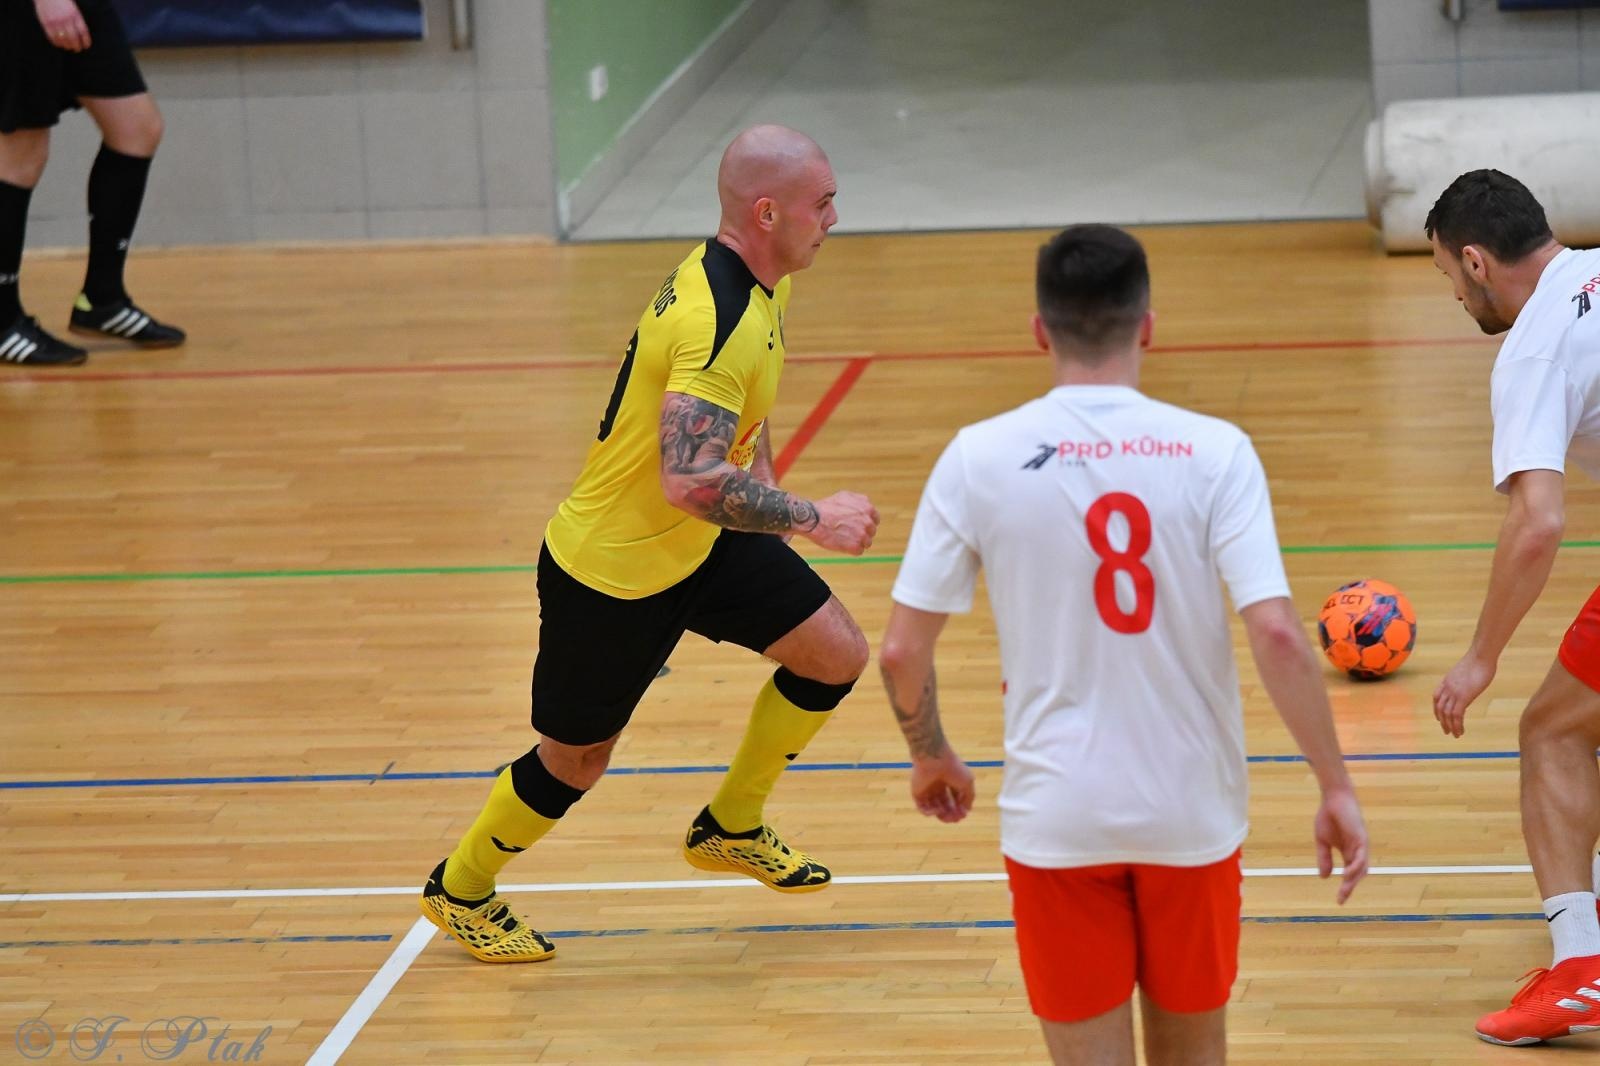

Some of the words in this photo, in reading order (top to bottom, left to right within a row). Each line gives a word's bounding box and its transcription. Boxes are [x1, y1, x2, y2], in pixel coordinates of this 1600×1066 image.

[1059, 441, 1113, 459] PRD
[1122, 436, 1192, 457] KÜHN
[1085, 491, 1155, 635] 8
